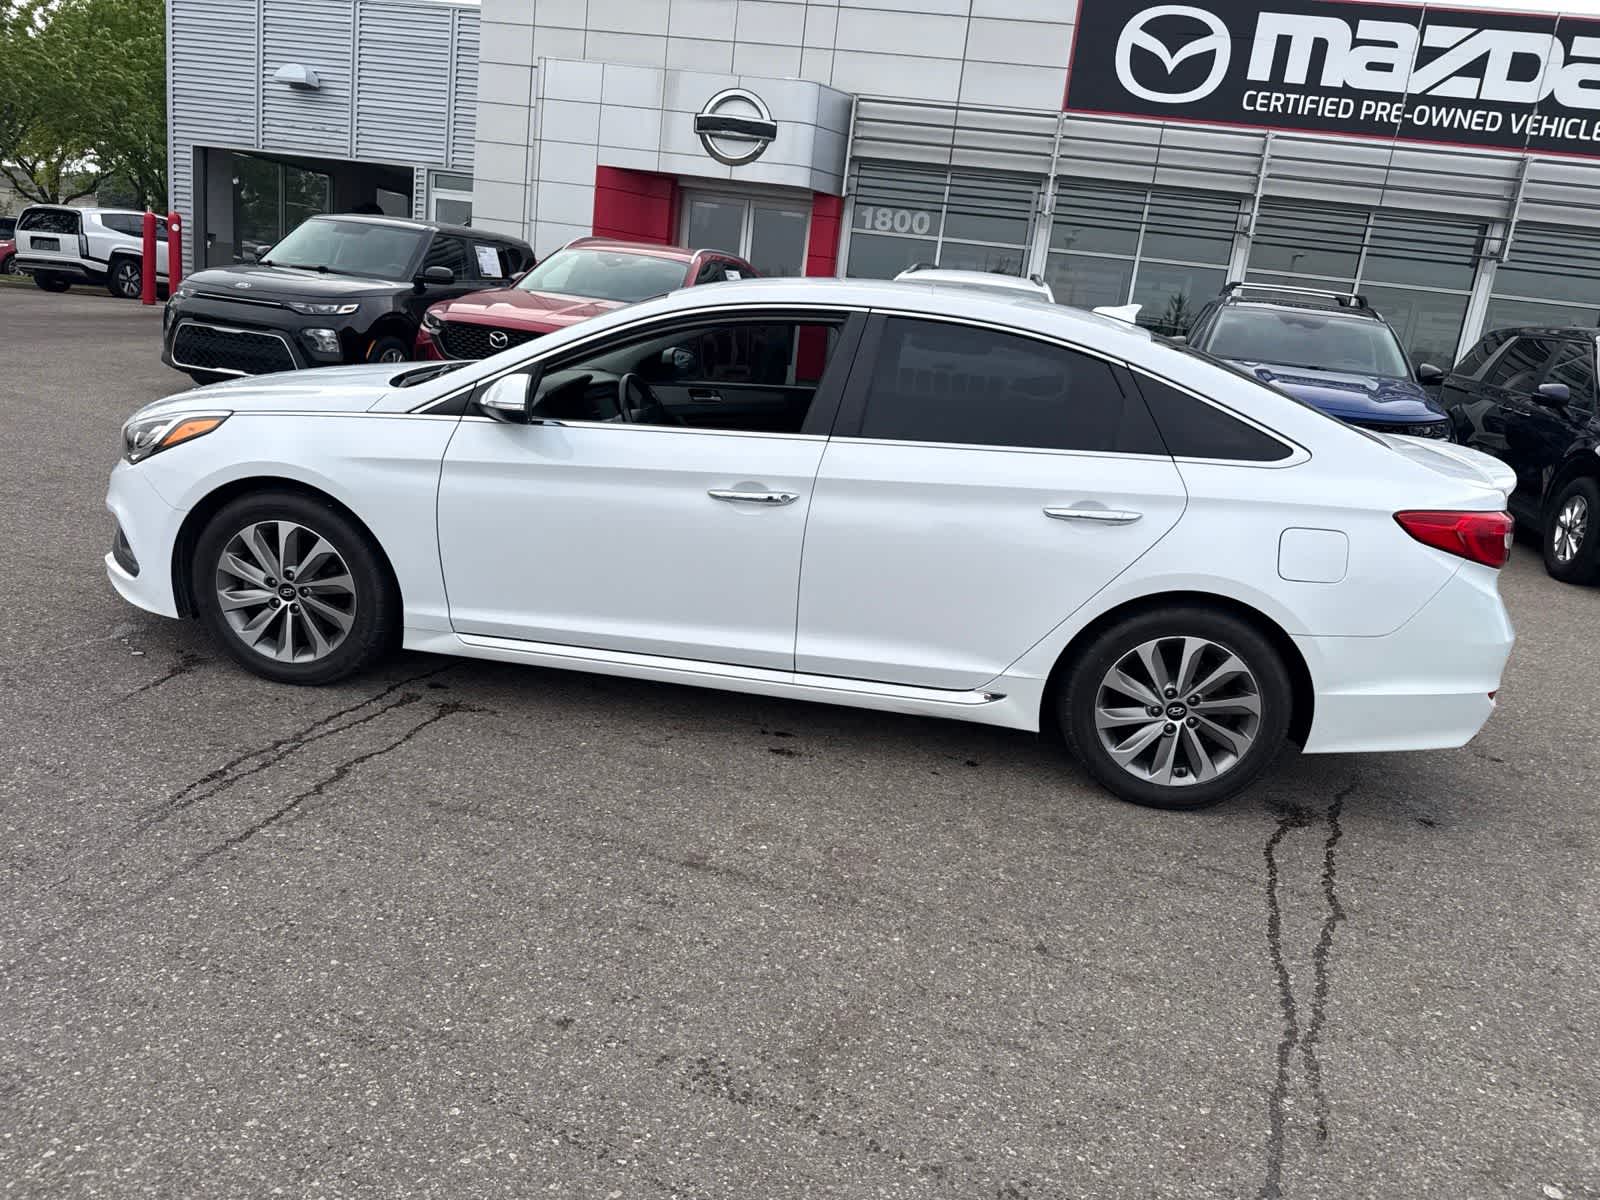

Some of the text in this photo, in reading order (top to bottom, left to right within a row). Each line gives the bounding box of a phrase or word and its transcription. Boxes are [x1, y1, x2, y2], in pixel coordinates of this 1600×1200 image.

[1242, 90, 1354, 119] CERTIFIED
[1360, 100, 1503, 132] PRE-OWNED
[861, 206, 930, 235] 1800
